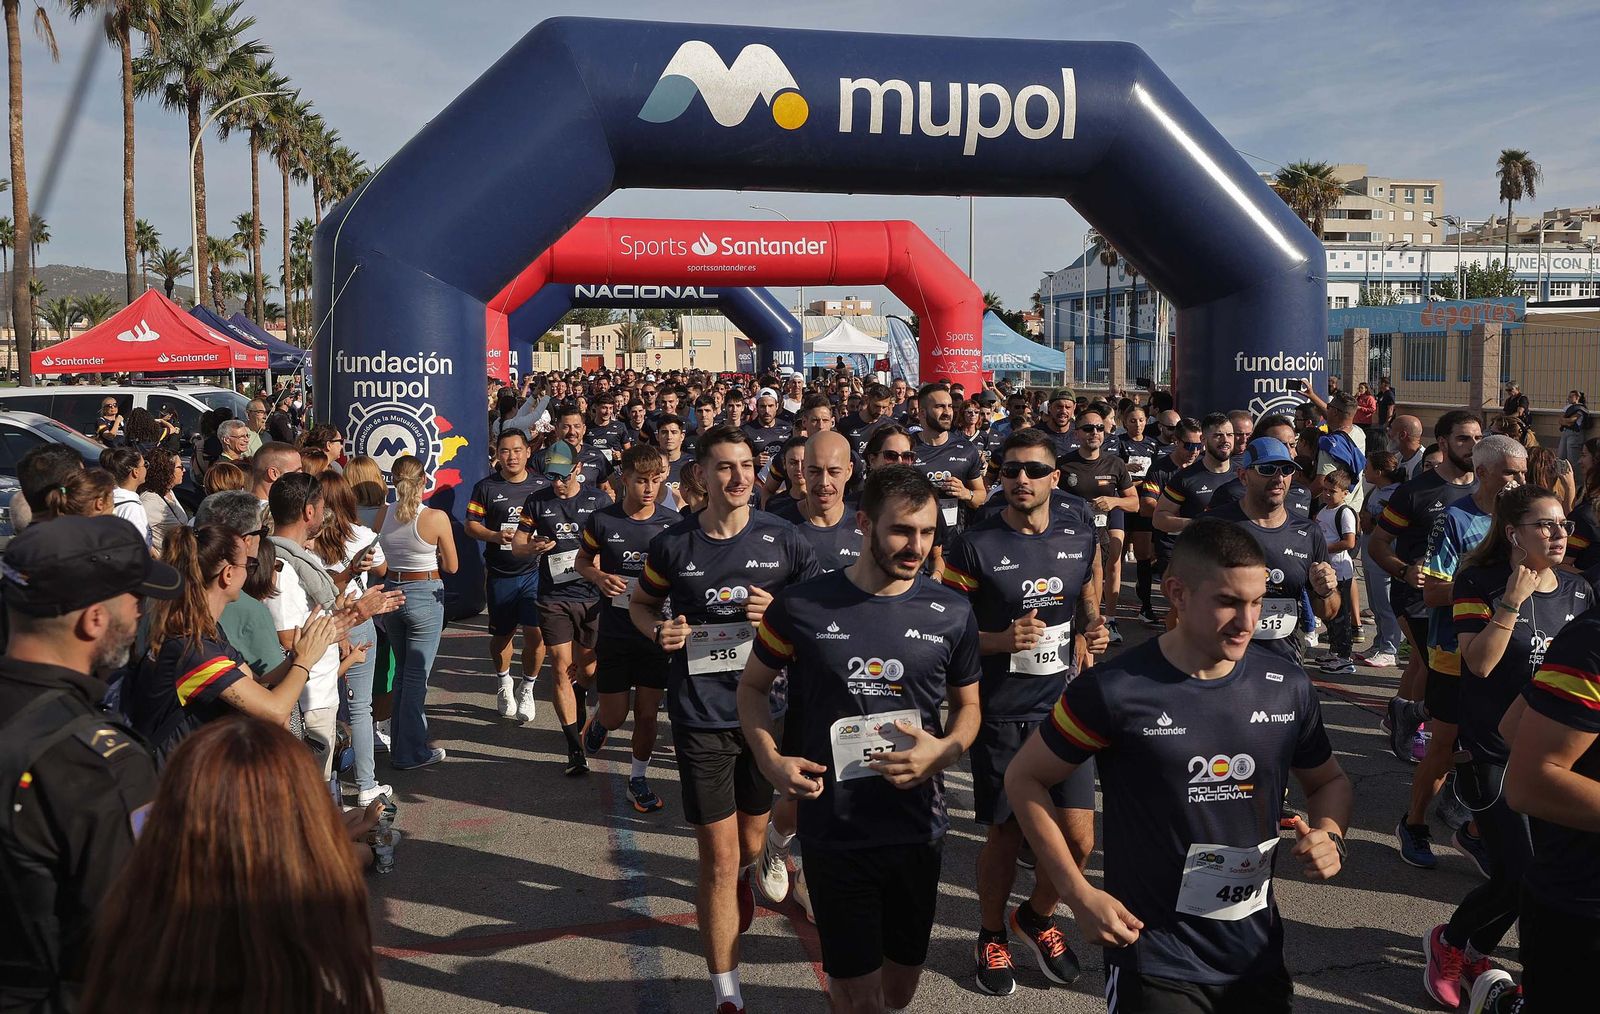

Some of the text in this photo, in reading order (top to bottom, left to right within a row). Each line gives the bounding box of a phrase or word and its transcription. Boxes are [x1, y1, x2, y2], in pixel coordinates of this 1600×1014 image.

[839, 68, 1075, 156] mupol
[620, 235, 828, 260] Sports Santander
[687, 264, 756, 273] sportssantander.es
[1553, 257, 1581, 269] CON
[575, 284, 719, 299] NACIONAL
[1421, 301, 1516, 328] deportes
[946, 332, 974, 343] Sports
[55, 356, 104, 366] Santander
[171, 353, 219, 362] Santander
[336, 350, 452, 375] fundación
[1235, 351, 1323, 372] fundación
[354, 376, 429, 403] mupol
[390, 415, 422, 437] Mutualidad
[760, 561, 779, 569] mupol
[993, 564, 1020, 572] Santander
[1022, 577, 1063, 598] 200
[705, 586, 748, 606] 200
[1023, 601, 1063, 609] NACIONAL
[1261, 619, 1282, 630] 513
[816, 632, 850, 640] Santander
[922, 633, 944, 643] mupol
[710, 648, 737, 660] 536
[1034, 651, 1056, 664] 192
[847, 656, 904, 681] 200
[847, 681, 890, 689] POLICIA
[848, 688, 901, 697] NACIONAL
[1271, 711, 1295, 724] mupol
[1143, 727, 1186, 736] Santander
[1188, 753, 1255, 783] 200
[1188, 784, 1240, 795] POLICIA
[1188, 792, 1252, 803] NACIONAL
